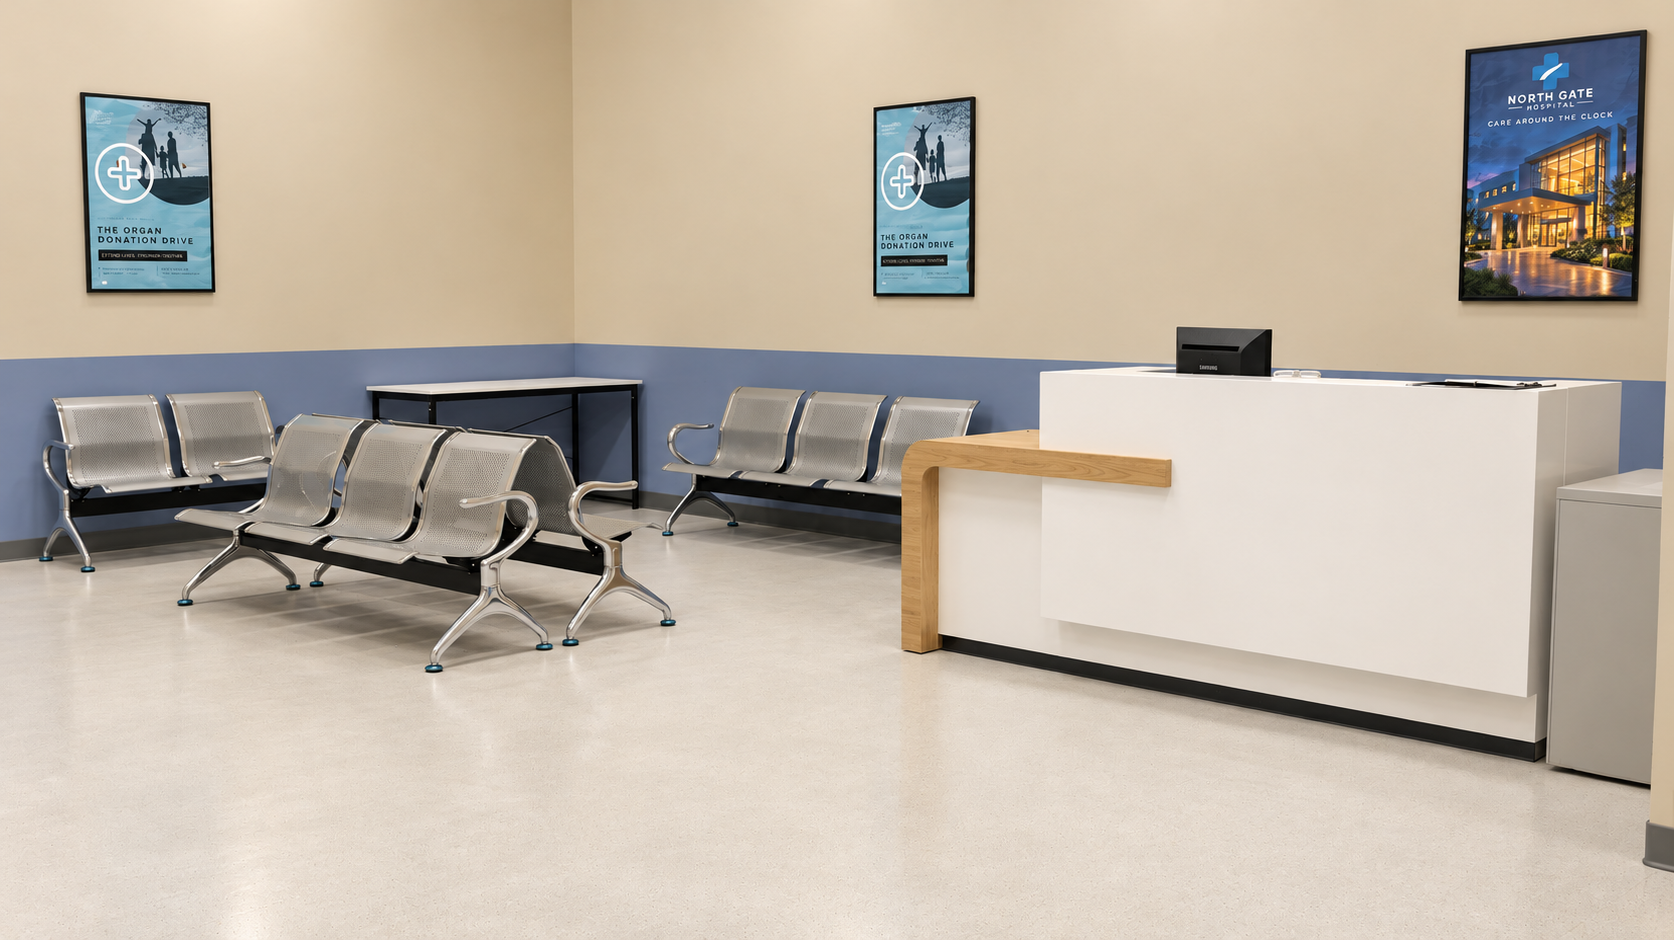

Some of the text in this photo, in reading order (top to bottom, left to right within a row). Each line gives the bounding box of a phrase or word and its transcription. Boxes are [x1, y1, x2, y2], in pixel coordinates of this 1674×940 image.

[1507, 88, 1593, 105] NORTH GATE
[1526, 102, 1575, 111] HOSPITAL
[1487, 119, 1511, 127] CARE
[1515, 116, 1554, 125] AROUND
[1581, 111, 1613, 120] CLOCK
[97, 226, 162, 235] THE ORGAN
[98, 236, 194, 245] DONATION DRIVE
